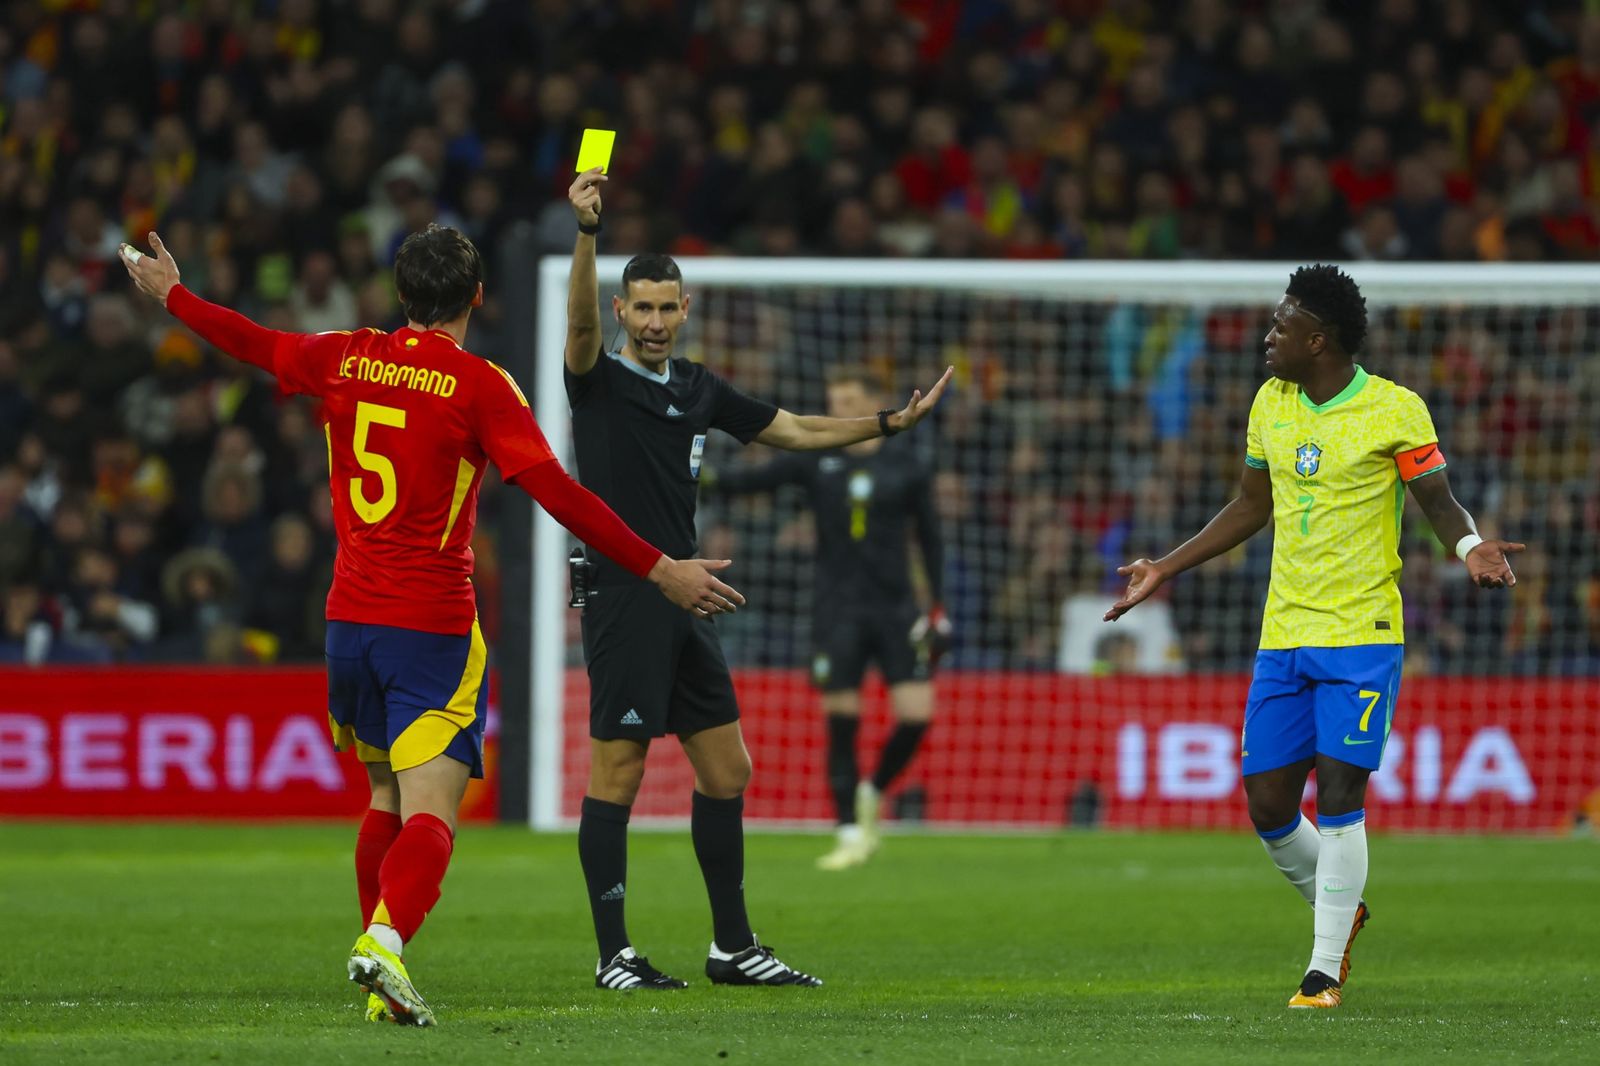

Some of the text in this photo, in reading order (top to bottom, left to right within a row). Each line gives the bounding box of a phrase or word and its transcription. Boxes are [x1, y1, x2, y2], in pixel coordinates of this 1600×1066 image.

[357, 356, 457, 398] NORMAND
[349, 400, 406, 524] 5
[1298, 496, 1315, 535] 7
[1359, 690, 1381, 733] 7
[0, 713, 344, 789] BERIA
[1117, 723, 1537, 804] IBIA
